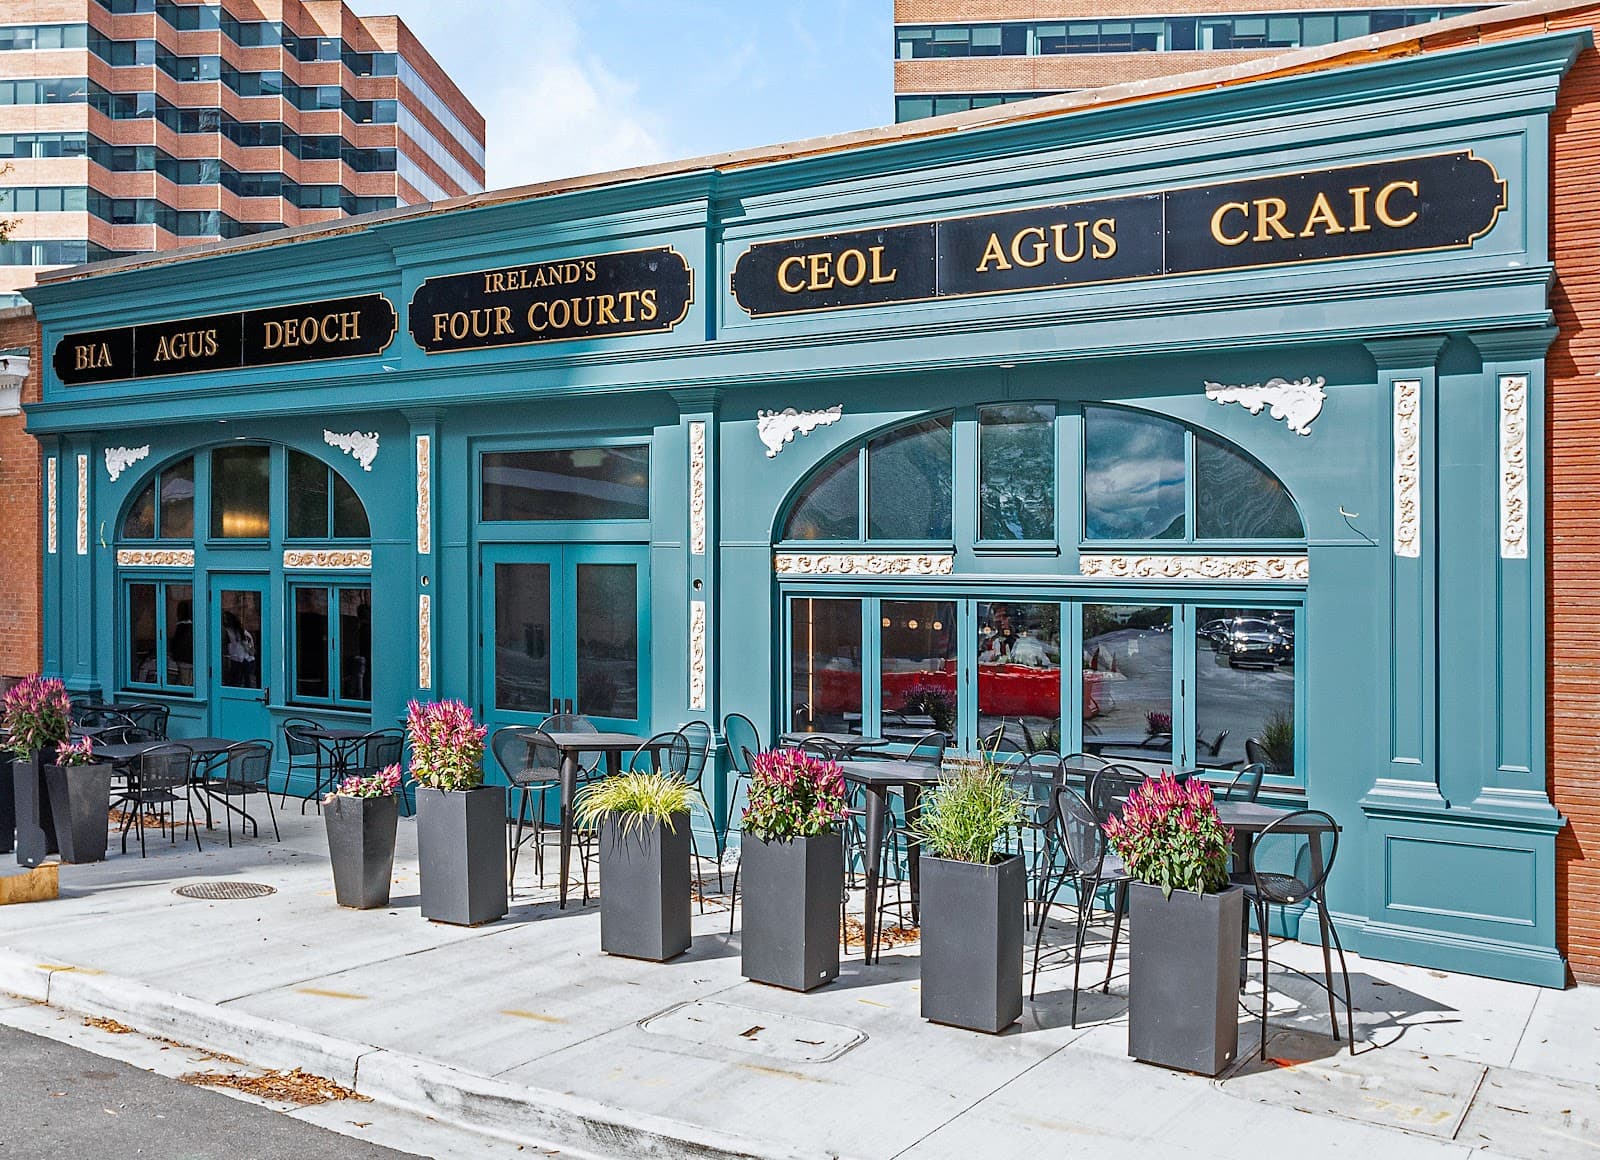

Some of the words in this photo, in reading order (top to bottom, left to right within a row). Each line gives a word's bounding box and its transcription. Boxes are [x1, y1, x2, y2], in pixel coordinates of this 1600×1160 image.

[776, 245, 897, 294] CEOL
[975, 217, 1118, 274] AGUS
[1210, 179, 1420, 246] CRAIC
[484, 261, 597, 294] IRELAND'S
[74, 343, 113, 370] BIA
[153, 329, 219, 362] AGUS
[263, 311, 361, 350] DEOCH
[432, 306, 515, 342] FOUR
[527, 289, 658, 332] COURTS
